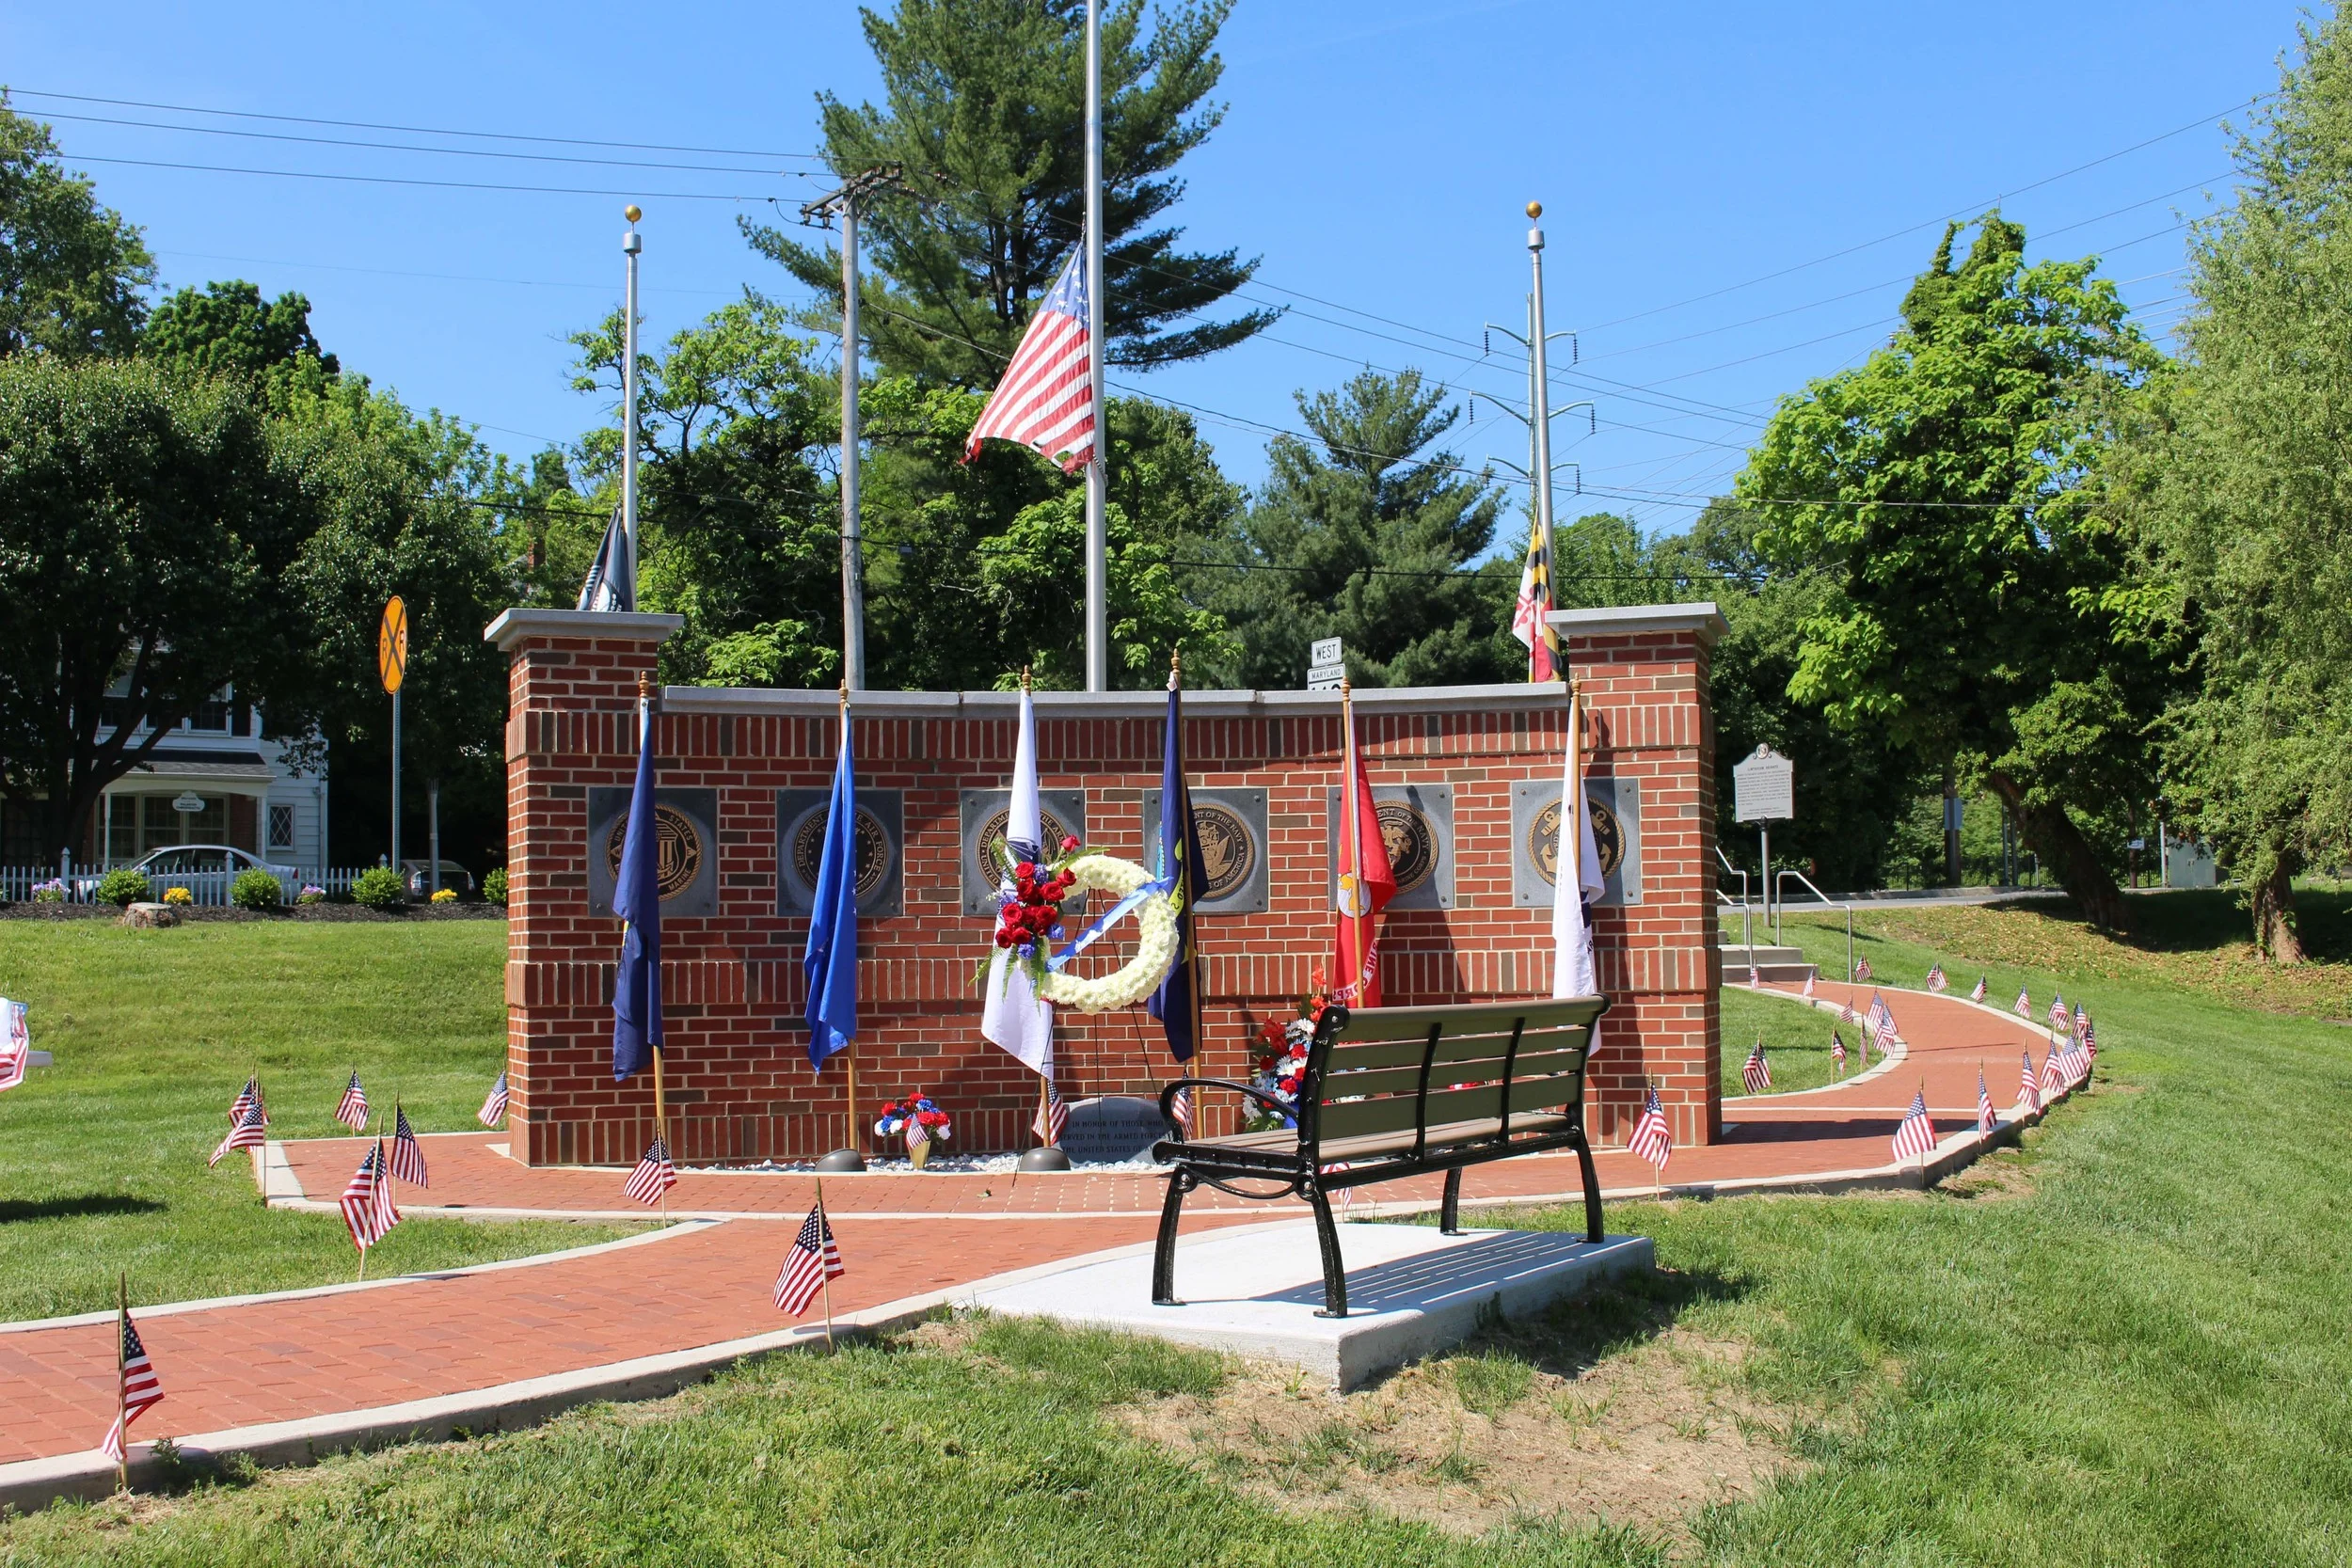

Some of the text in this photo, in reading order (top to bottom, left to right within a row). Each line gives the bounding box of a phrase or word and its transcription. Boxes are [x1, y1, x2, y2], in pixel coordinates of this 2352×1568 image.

[382, 629, 405, 659] R R
[1316, 644, 1336, 659] WEST
[1312, 669, 1341, 679] MARYLAND
[669, 815, 693, 841] STATES
[797, 814, 824, 867] DEPARTMENT
[981, 812, 1009, 847] DEPARTME
[1216, 814, 1231, 826] THE
[1230, 823, 1243, 842] NAVY
[1417, 826, 1429, 848] NAVY
[865, 821, 884, 872] AIR FORCE
[668, 867, 691, 890] MARINE
[981, 856, 999, 884] UNITED
[1214, 852, 1245, 887] OF AMERICA
[1414, 855, 1428, 874] CORPS
